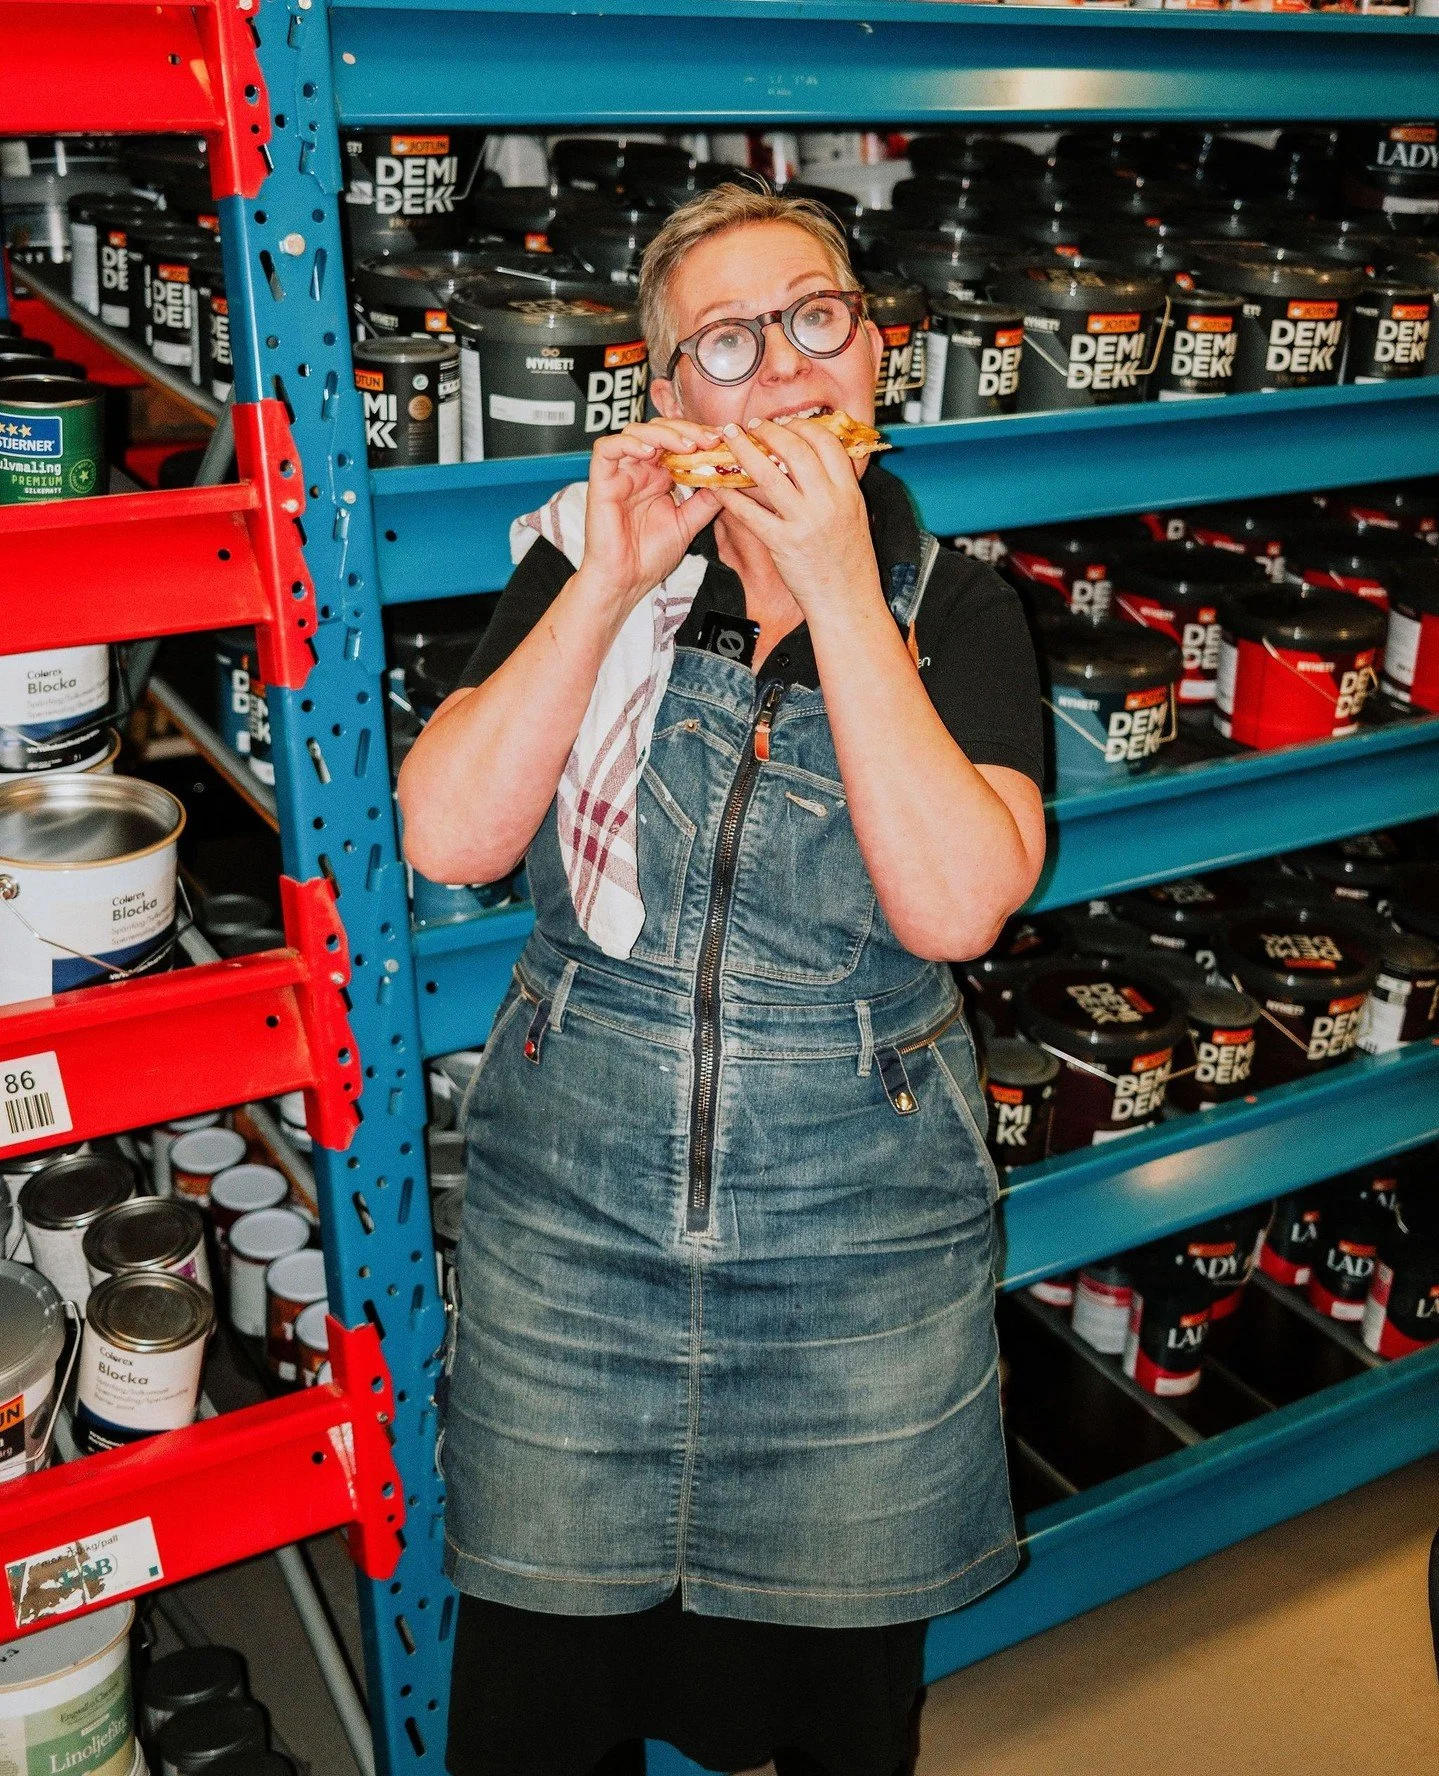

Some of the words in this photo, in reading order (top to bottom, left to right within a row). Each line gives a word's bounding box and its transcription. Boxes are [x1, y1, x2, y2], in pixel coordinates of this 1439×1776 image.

[376, 156, 457, 186] DEMI
[1269, 319, 1342, 347] DEMI
[1070, 332, 1146, 362] DEMI
[526, 356, 574, 370] NYHET!
[587, 362, 649, 402] DEM
[363, 393, 397, 421] MI
[365, 421, 398, 448] KK
[12, 475, 62, 486] PREMIUM
[4, 1069, 36, 1095] 86
[998, 1103, 1032, 1125] MI
[996, 1123, 1028, 1146] KK
[1291, 1223, 1317, 1242] LA
[1327, 1249, 1374, 1277] LAD
[98, 1361, 148, 1385] Blocka
